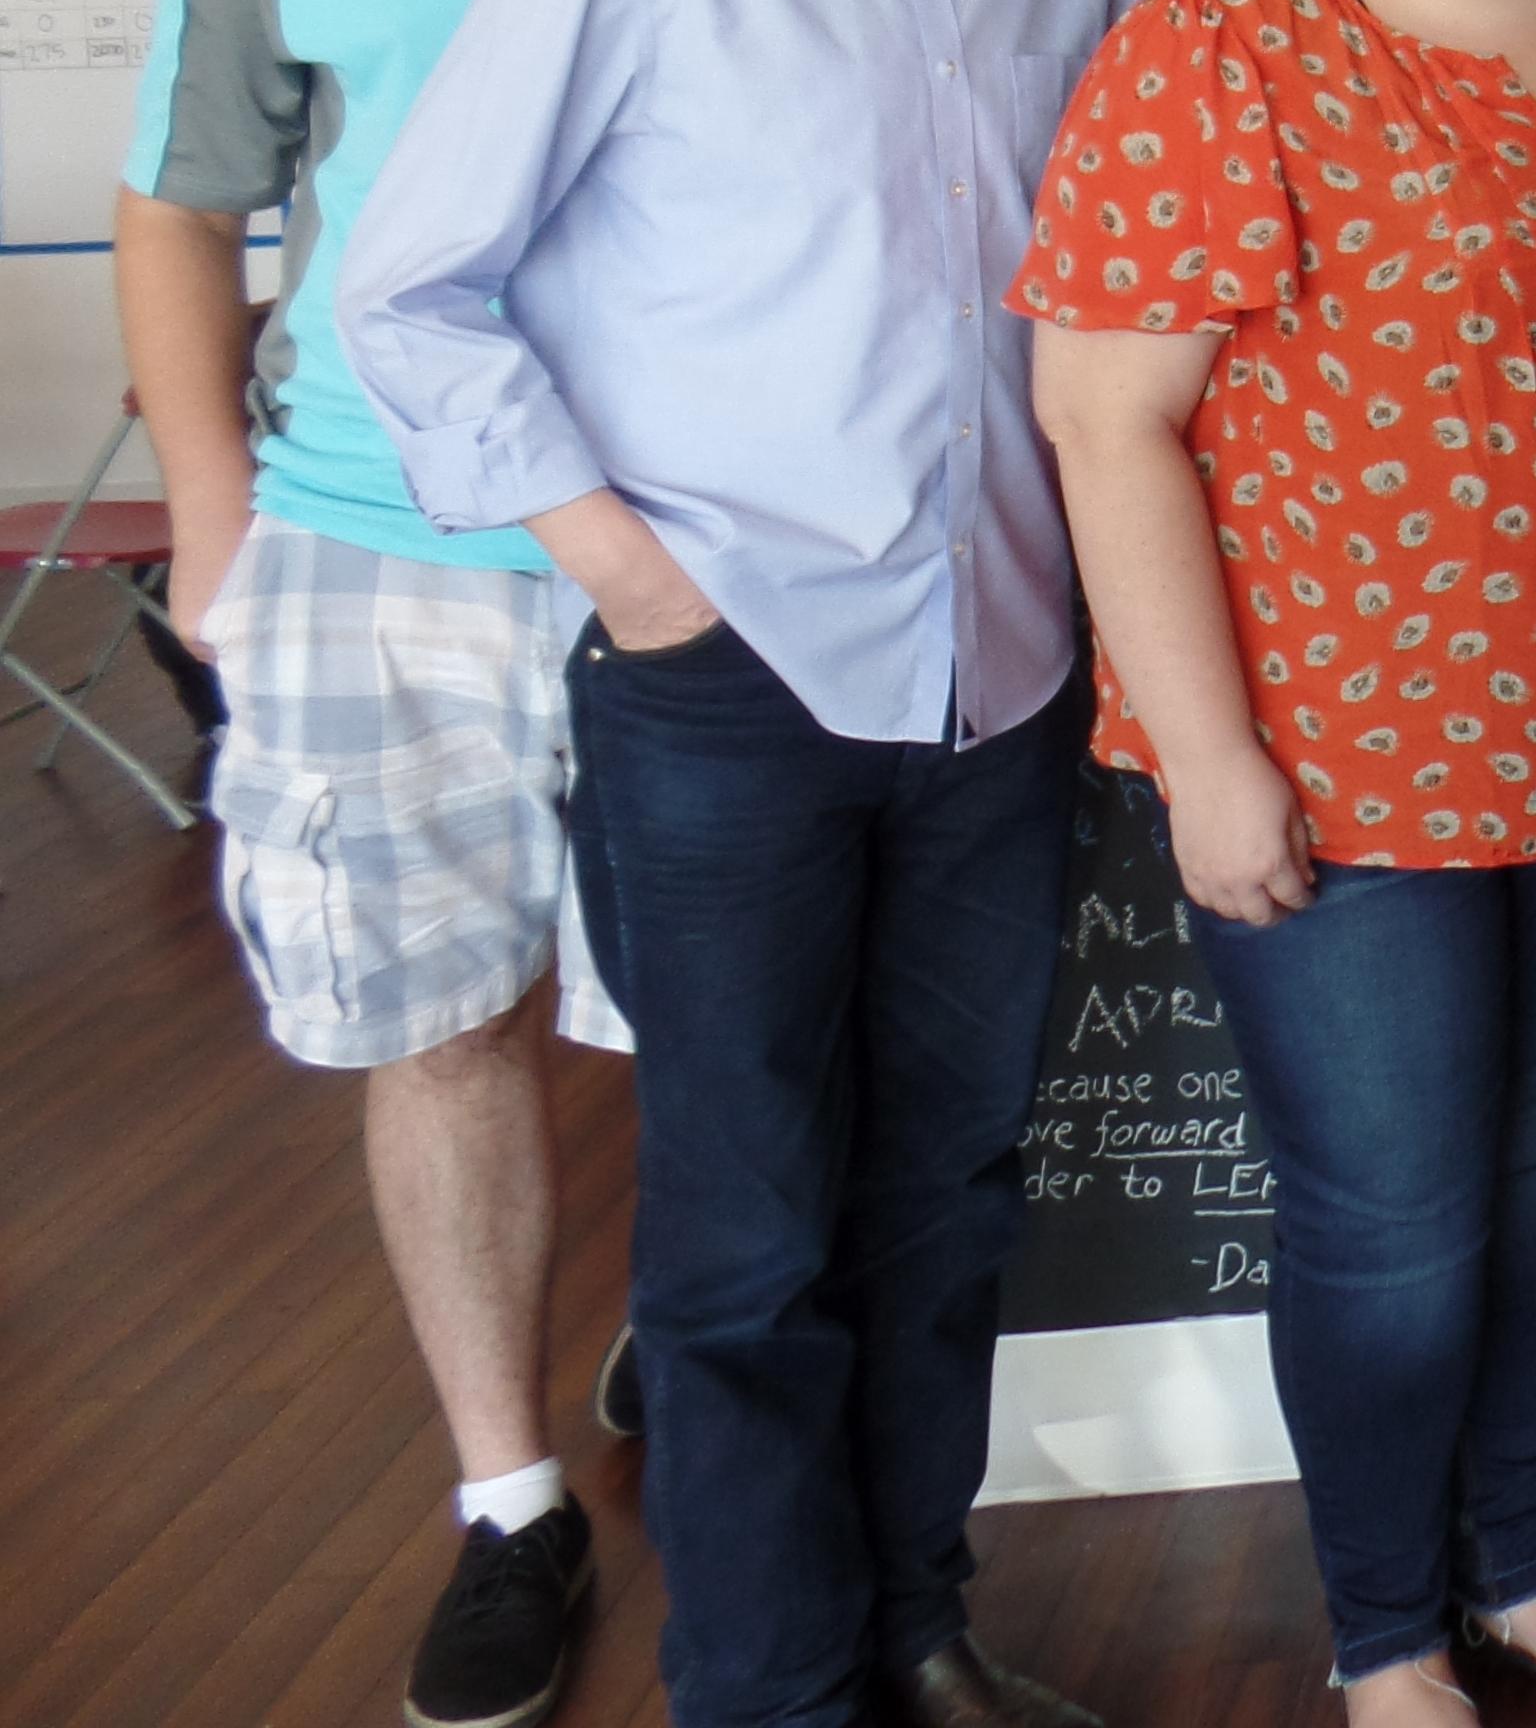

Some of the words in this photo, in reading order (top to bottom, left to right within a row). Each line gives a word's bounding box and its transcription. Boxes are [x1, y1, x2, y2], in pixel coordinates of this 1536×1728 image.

[1179, 1068, 1241, 1100] one
[1091, 1113, 1246, 1158] forward
[1121, 1168, 1161, 1200] to
